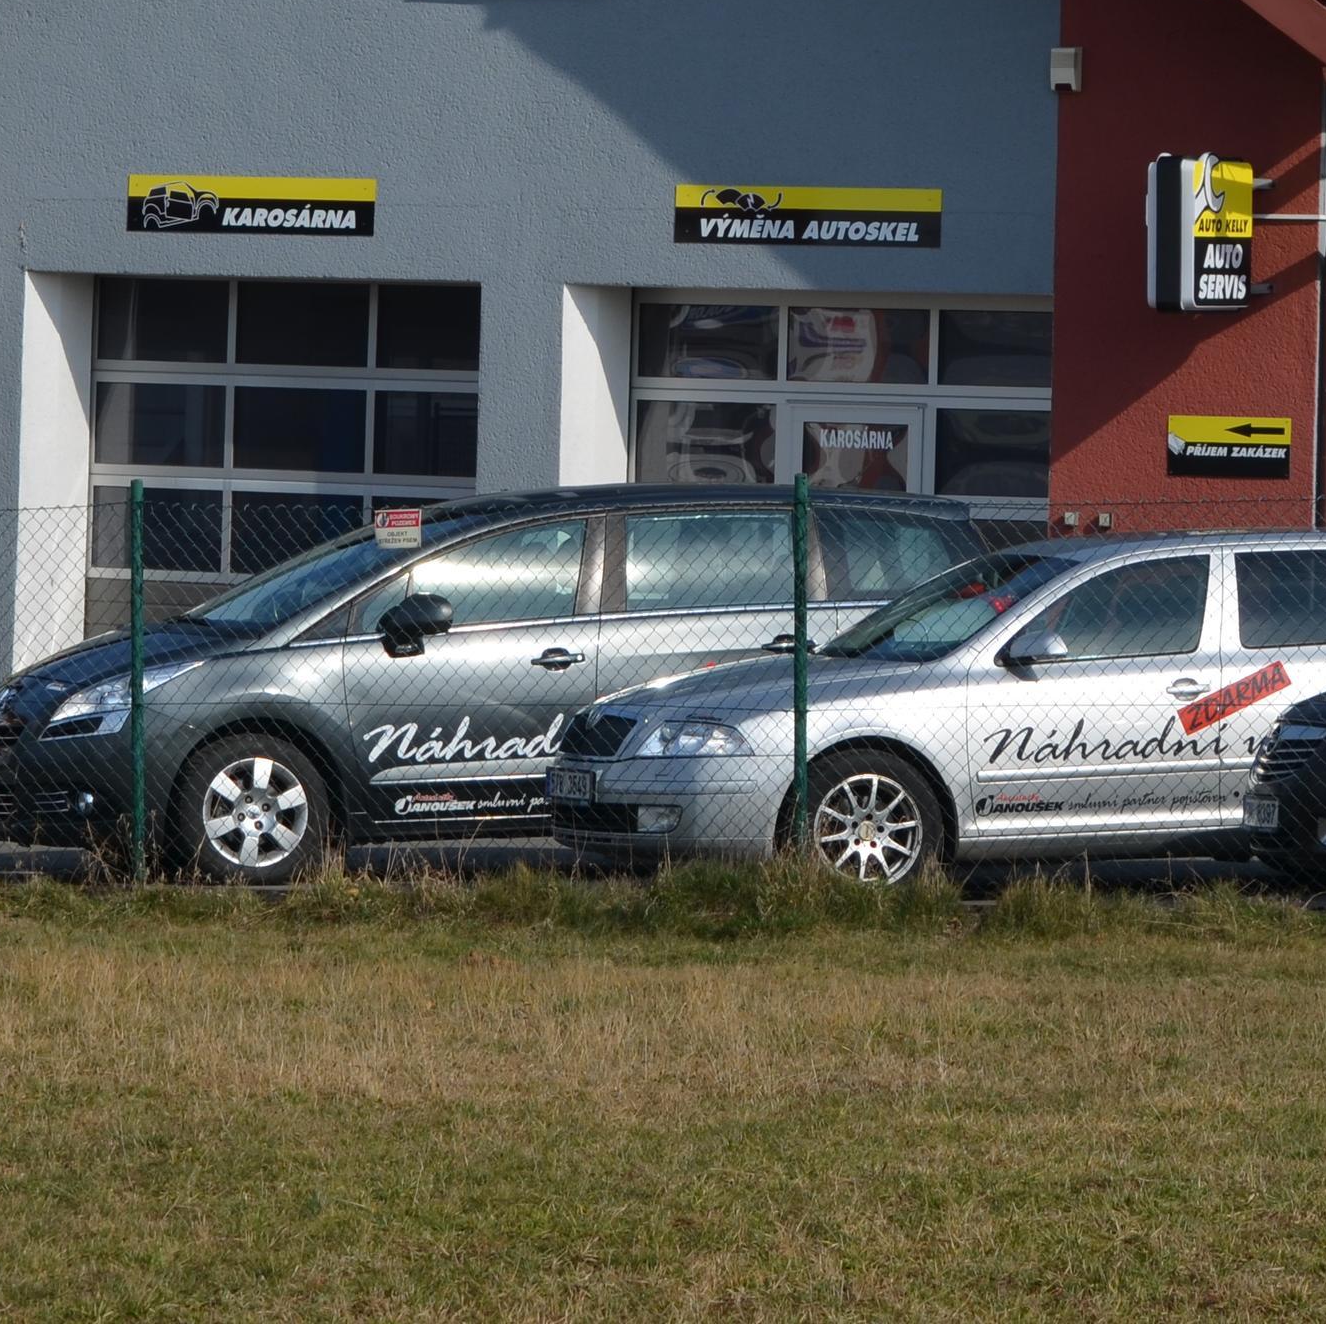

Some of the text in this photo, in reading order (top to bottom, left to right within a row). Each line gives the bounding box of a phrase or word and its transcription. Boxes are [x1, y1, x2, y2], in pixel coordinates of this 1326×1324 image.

[221, 204, 356, 229] KAROSÁRNA
[700, 213, 919, 242] VÝMĚNA AUTOSKEL
[1198, 219, 1249, 232] AUTO KELLY
[1203, 243, 1243, 269] AUTO
[1198, 274, 1247, 300] SERVIS
[819, 427, 894, 450] KAROSÁRNA
[1186, 443, 1286, 458] PŘÍJEM ZAKÁZEK
[1187, 666, 1286, 729] ZDARMA
[984, 717, 1230, 765] Náhradní
